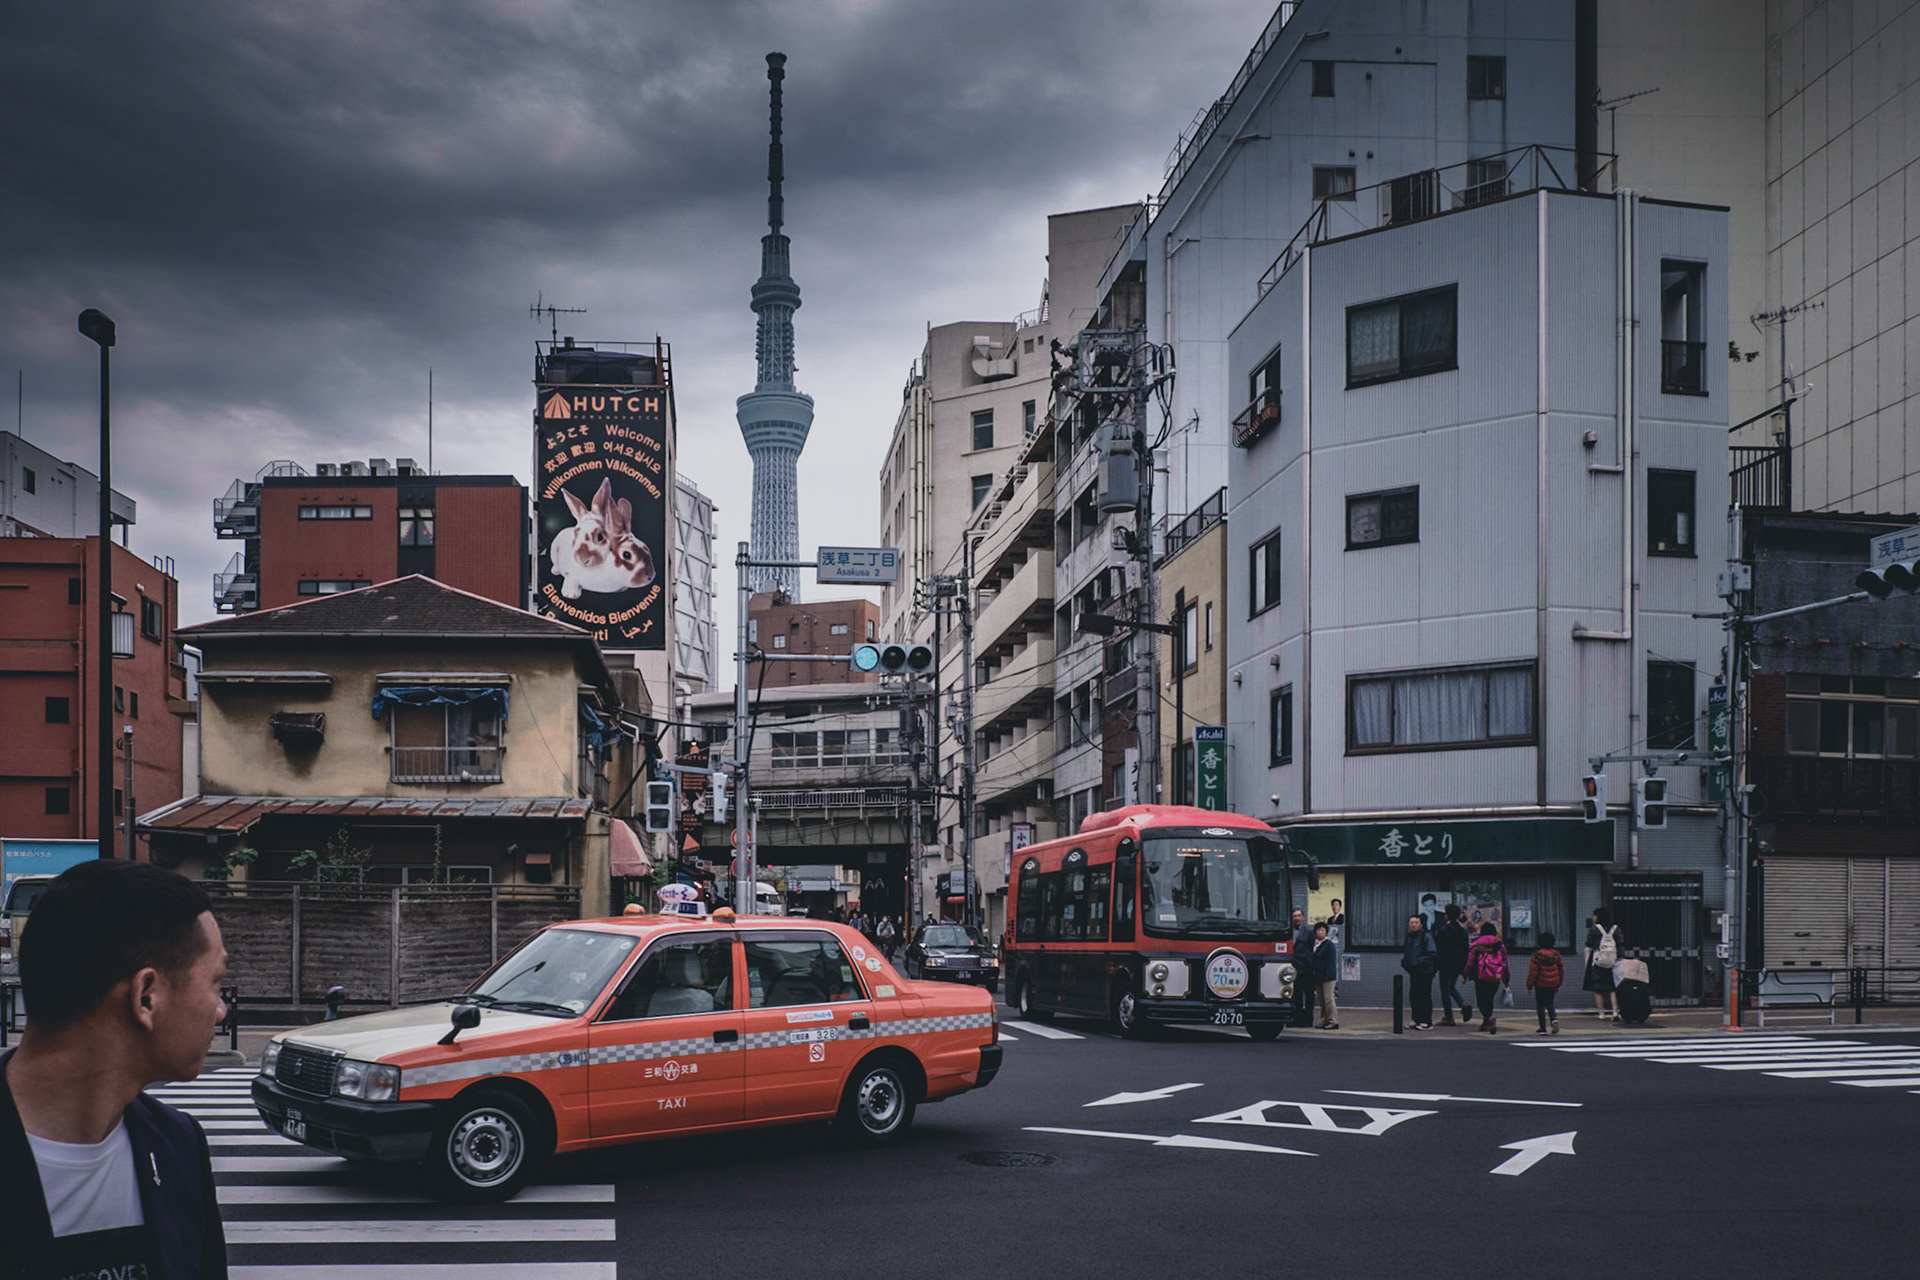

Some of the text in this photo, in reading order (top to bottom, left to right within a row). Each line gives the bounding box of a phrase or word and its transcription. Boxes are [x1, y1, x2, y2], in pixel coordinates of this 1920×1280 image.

[573, 396, 659, 412] HUTCH
[546, 424, 589, 450] ようこそ
[605, 424, 661, 452] Welcome
[544, 451, 569, 473] 欢迎
[603, 441, 661, 474] 어서오십시오
[543, 460, 603, 500] Willkommen
[822, 551, 895, 567] 浅草二丁目
[836, 568, 880, 577] Asakusa 2
[542, 583, 661, 625] Bienvenidos Bienvenue
[1198, 729, 1223, 739] Asahi
[1378, 828, 1454, 859] 香とり
[816, 1029, 836, 1040] 328
[657, 1097, 687, 1110] TAXI
